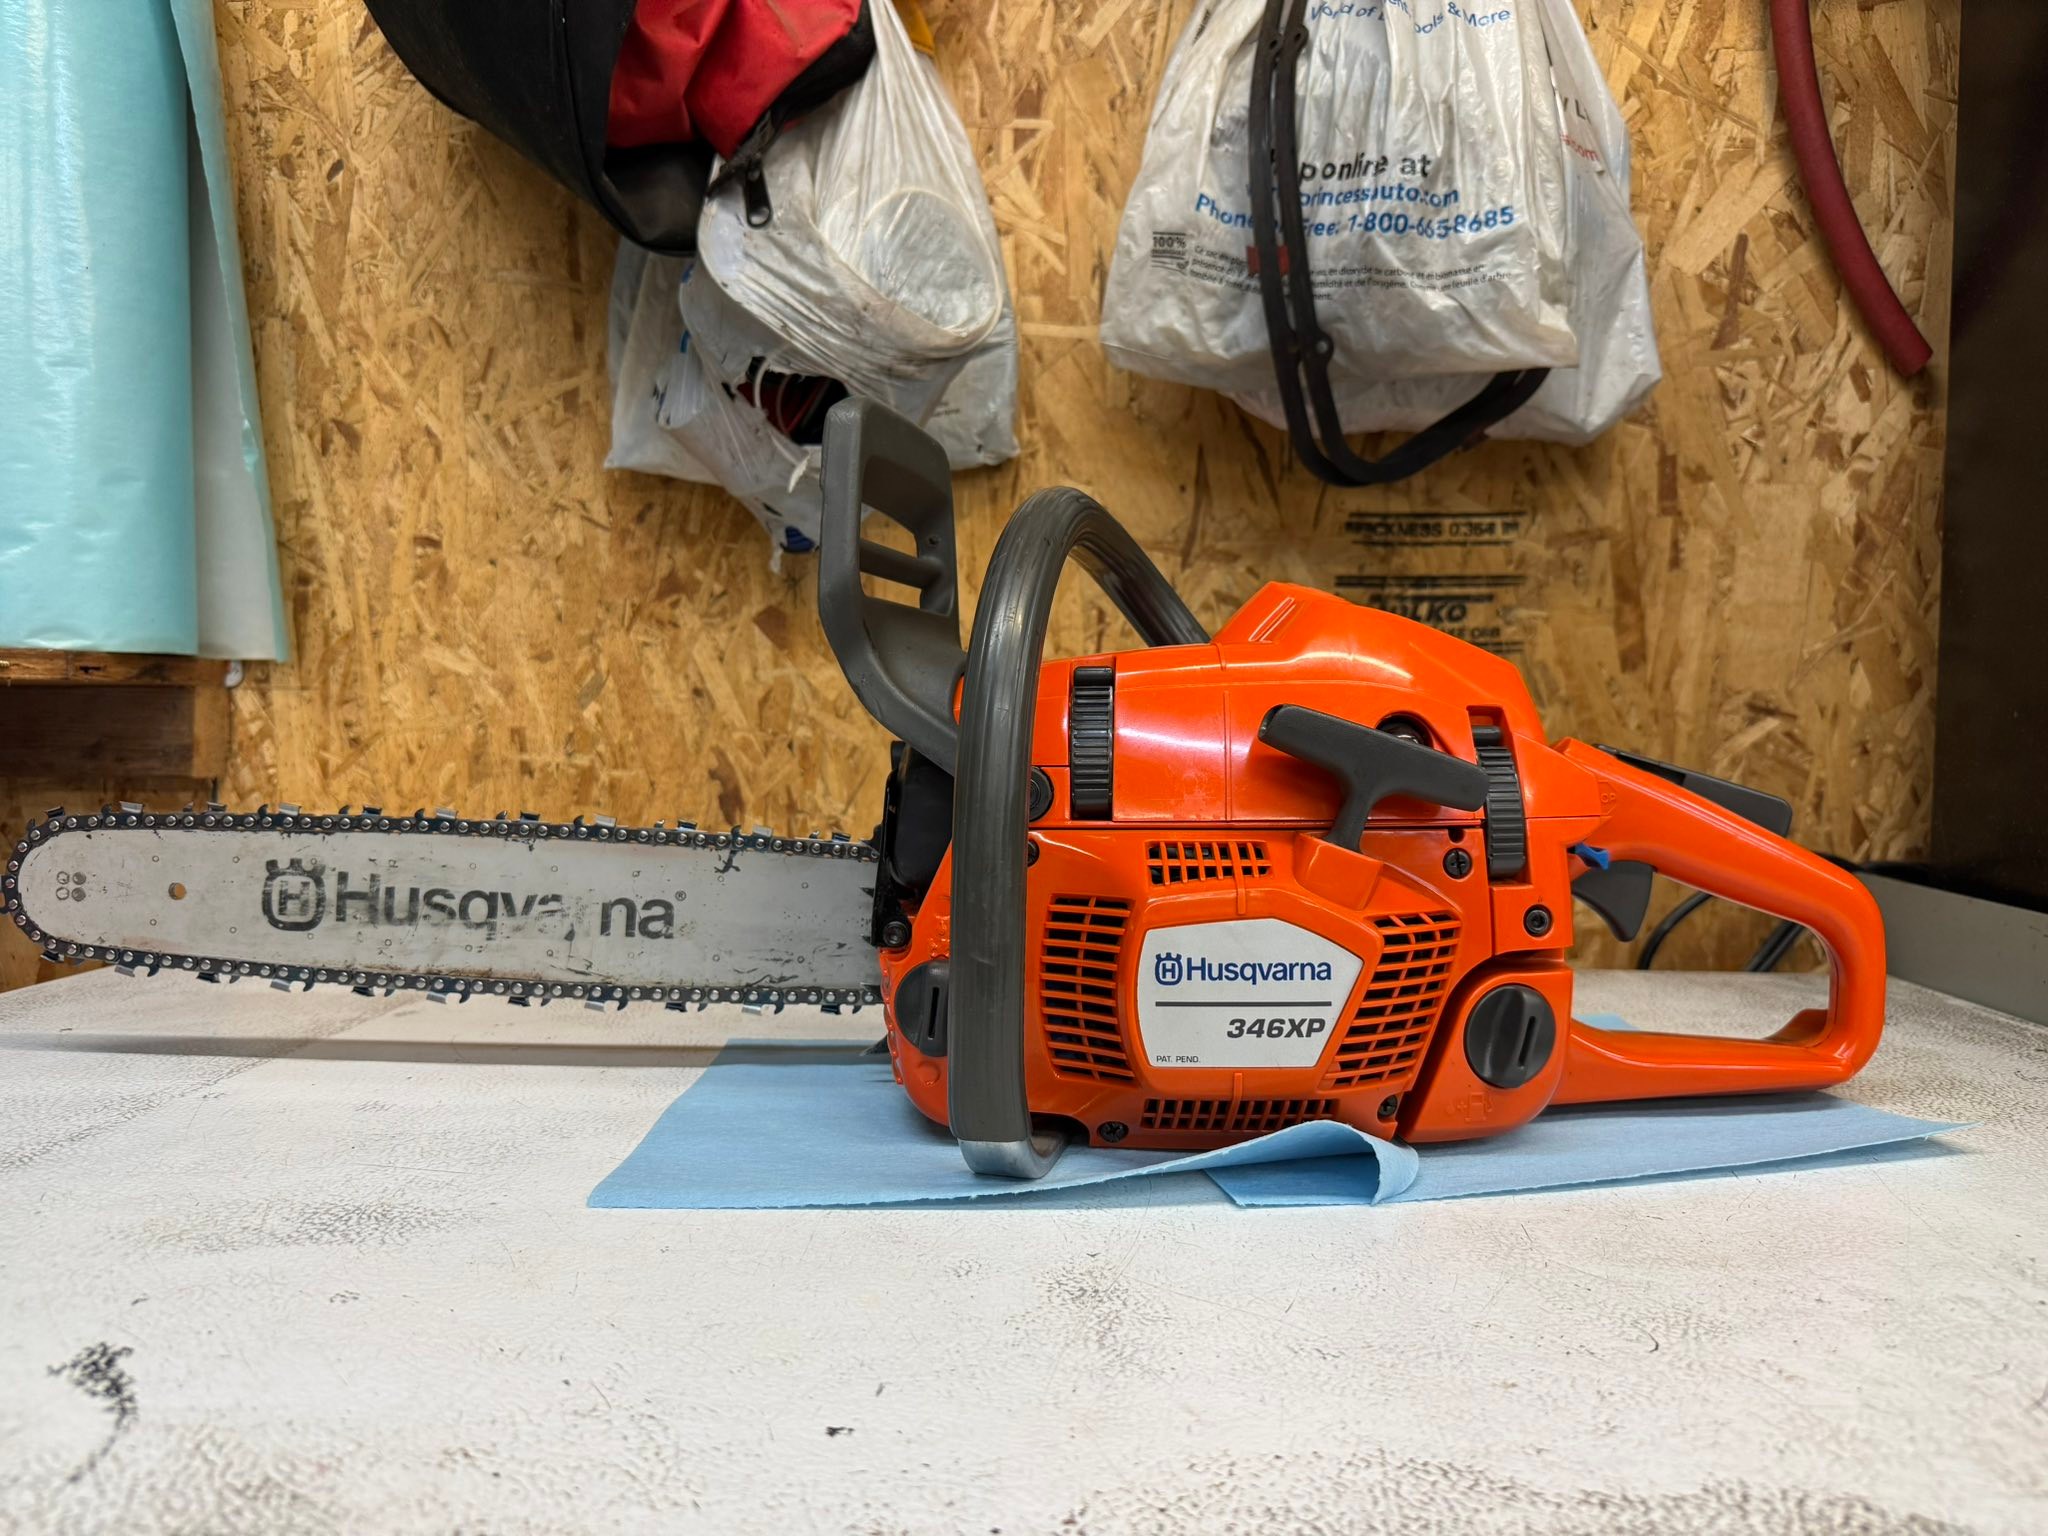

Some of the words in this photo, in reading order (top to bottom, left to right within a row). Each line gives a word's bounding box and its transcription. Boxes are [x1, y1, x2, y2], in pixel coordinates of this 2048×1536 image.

[1356, 6, 1377, 17] of
[1414, 15, 1443, 34] ools
[1463, 8, 1512, 28] More
[1401, 153, 1432, 177] at
[1347, 205, 1515, 240] 1-800-665-8685
[1152, 236, 1187, 249] 100%
[335, 870, 676, 941] Husqvana
[1186, 957, 1332, 985] Husqvarna
[1226, 1018, 1326, 1039] 346XP
[1156, 1055, 1173, 1063] PAT.
[1175, 1055, 1201, 1063] PEND.
